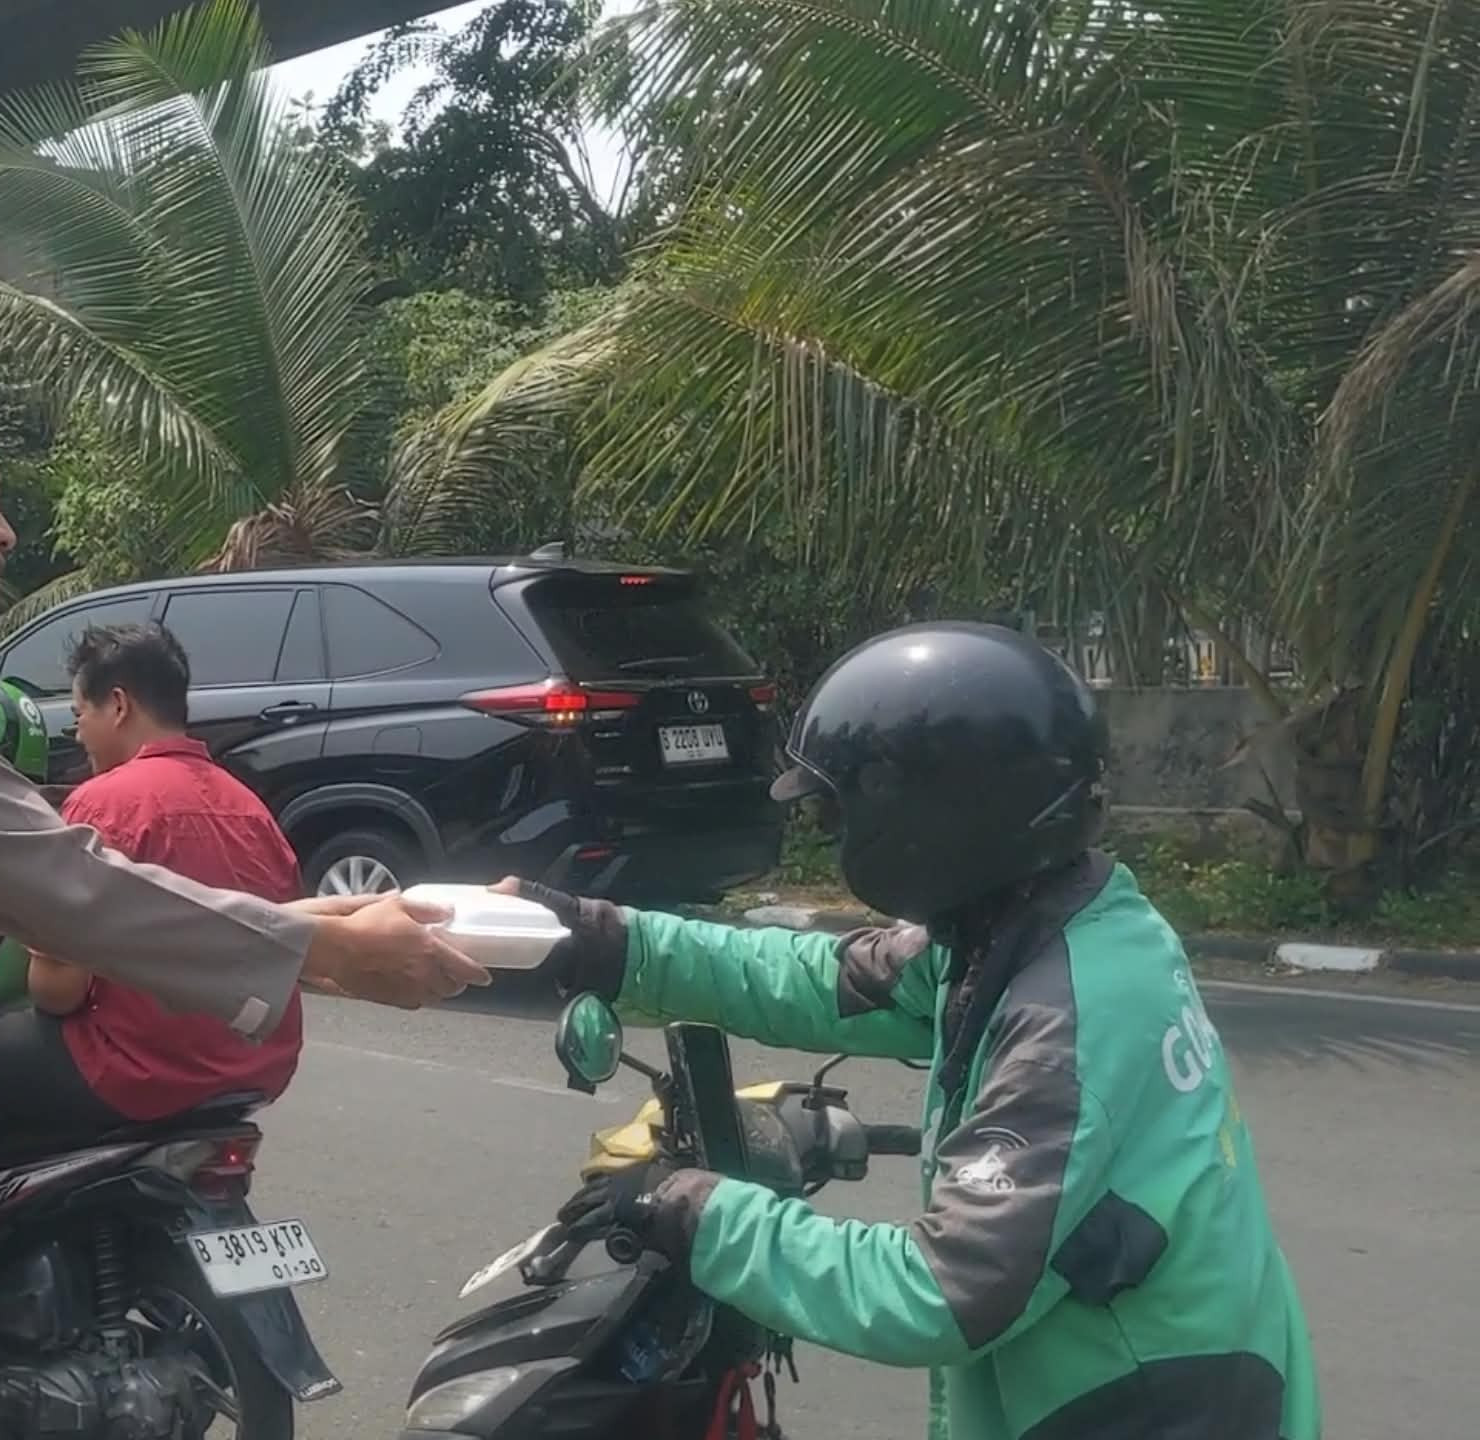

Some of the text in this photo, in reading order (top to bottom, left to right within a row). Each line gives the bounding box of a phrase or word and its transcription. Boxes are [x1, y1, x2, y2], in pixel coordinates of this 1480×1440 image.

[195, 1225, 303, 1263] B 3819 KTP
